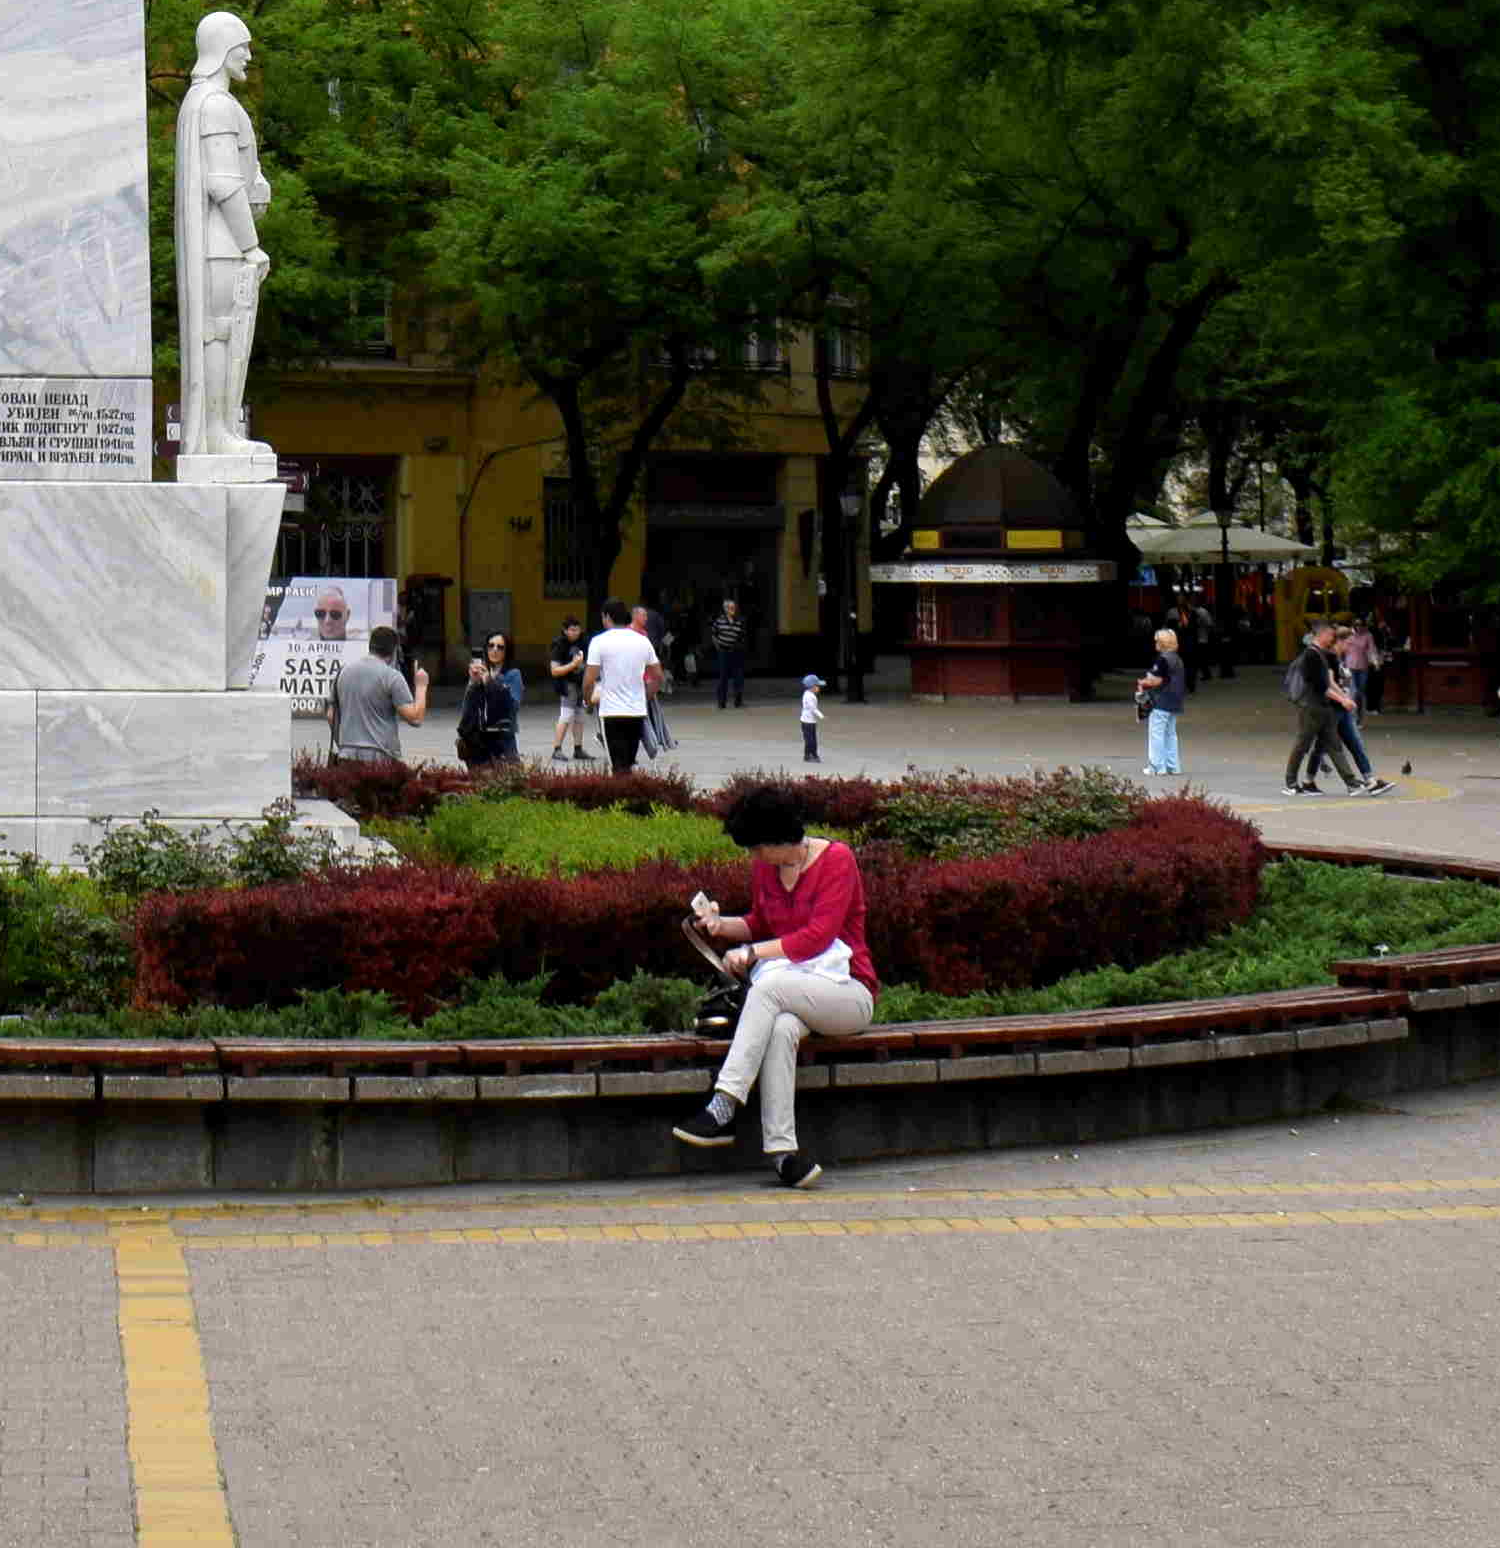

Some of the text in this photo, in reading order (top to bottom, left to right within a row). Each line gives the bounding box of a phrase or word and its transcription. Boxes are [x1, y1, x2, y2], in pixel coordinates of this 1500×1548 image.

[44, 392, 88, 408] НЕНАД
[7, 407, 59, 420] УБИЈЕН
[23, 422, 88, 436] ПОДИГНУТ
[38, 437, 46, 449] И
[50, 437, 98, 450] СРУШЕН
[38, 451, 46, 463] И
